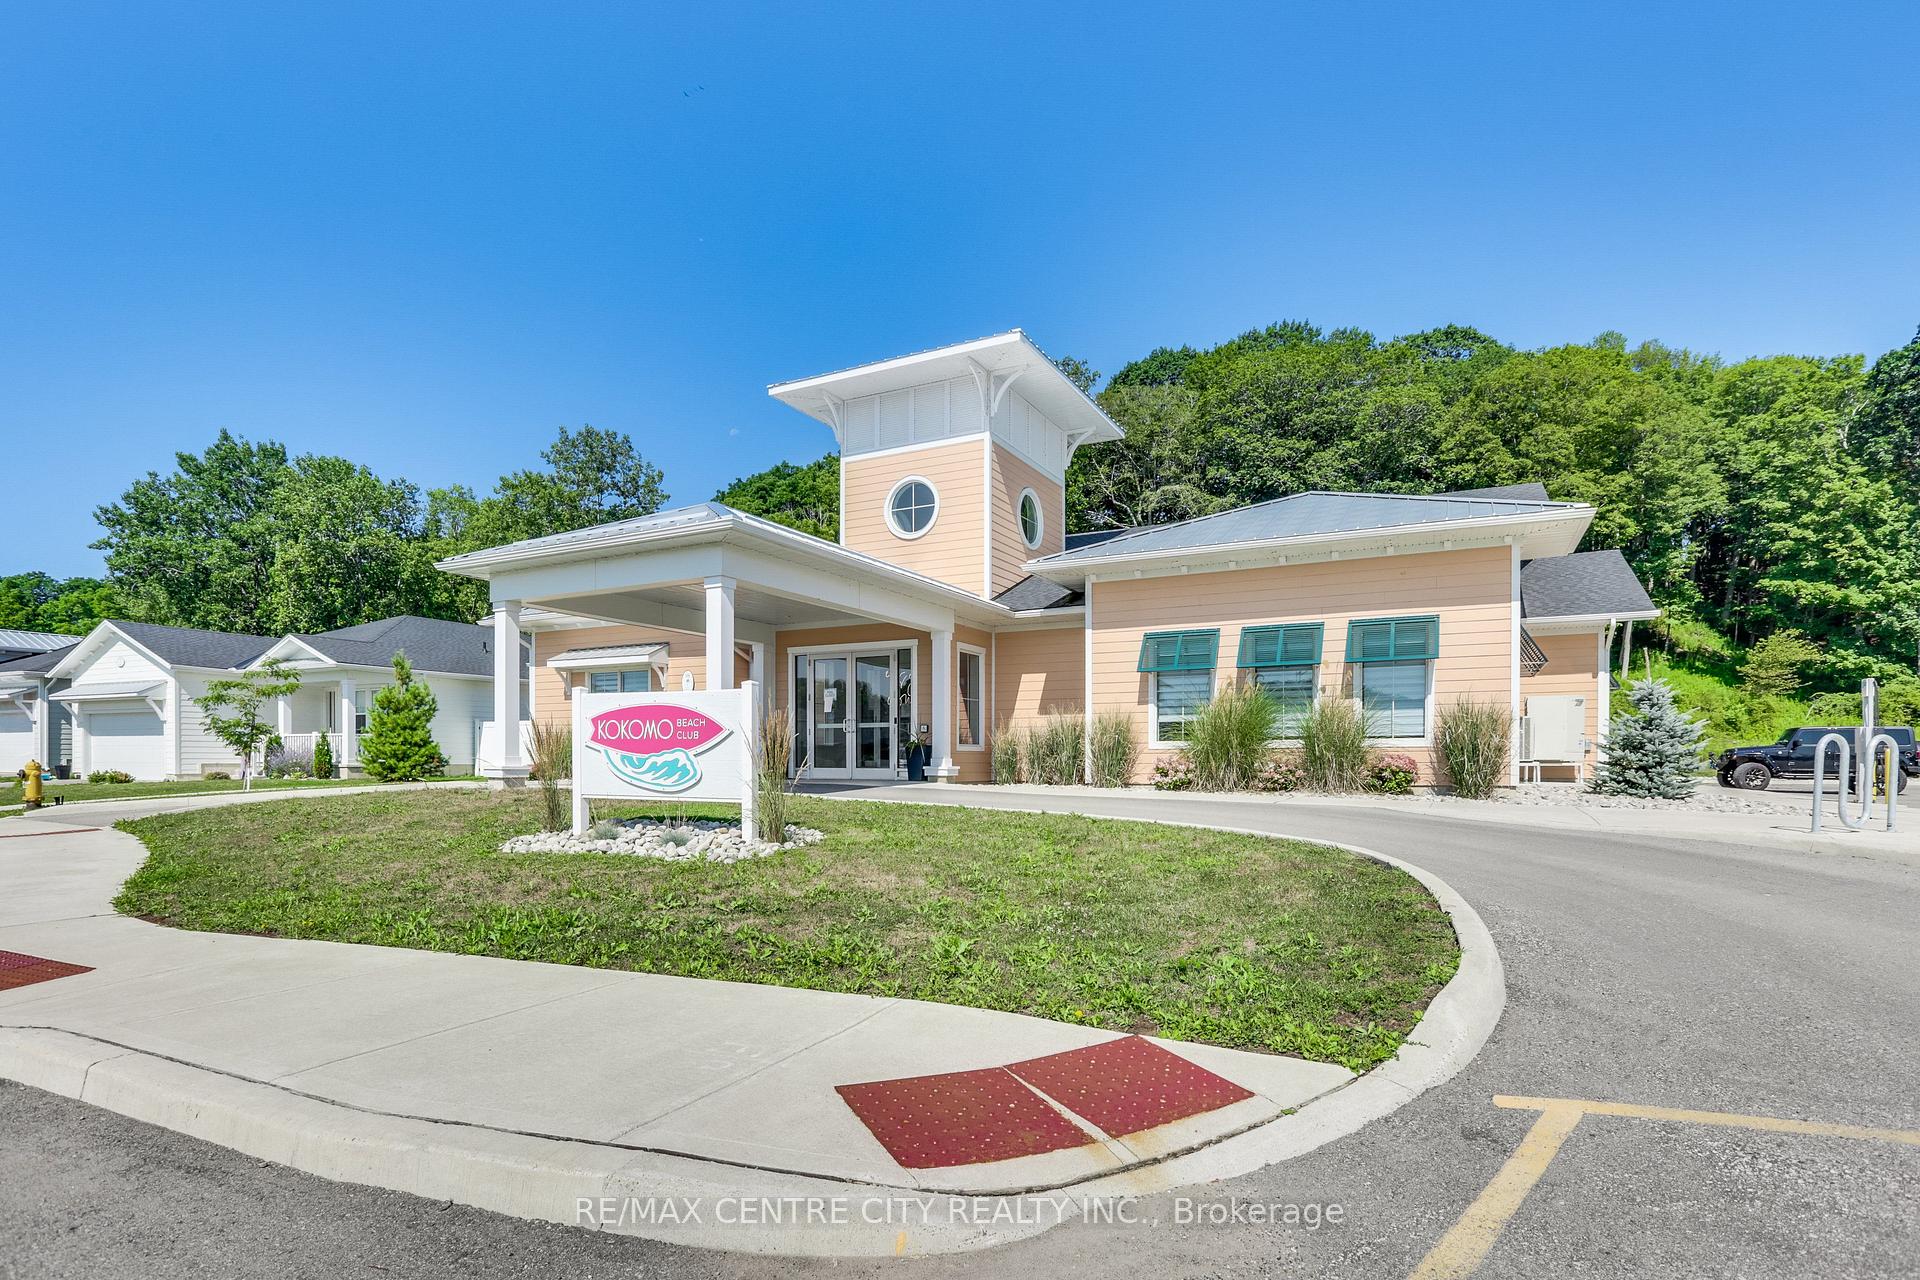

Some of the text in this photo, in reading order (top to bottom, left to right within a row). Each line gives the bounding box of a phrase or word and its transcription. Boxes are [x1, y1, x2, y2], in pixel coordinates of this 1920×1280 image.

[676, 718, 706, 728] BEACH
[597, 719, 674, 740] KOKOMO
[676, 731, 700, 740] CLUB
